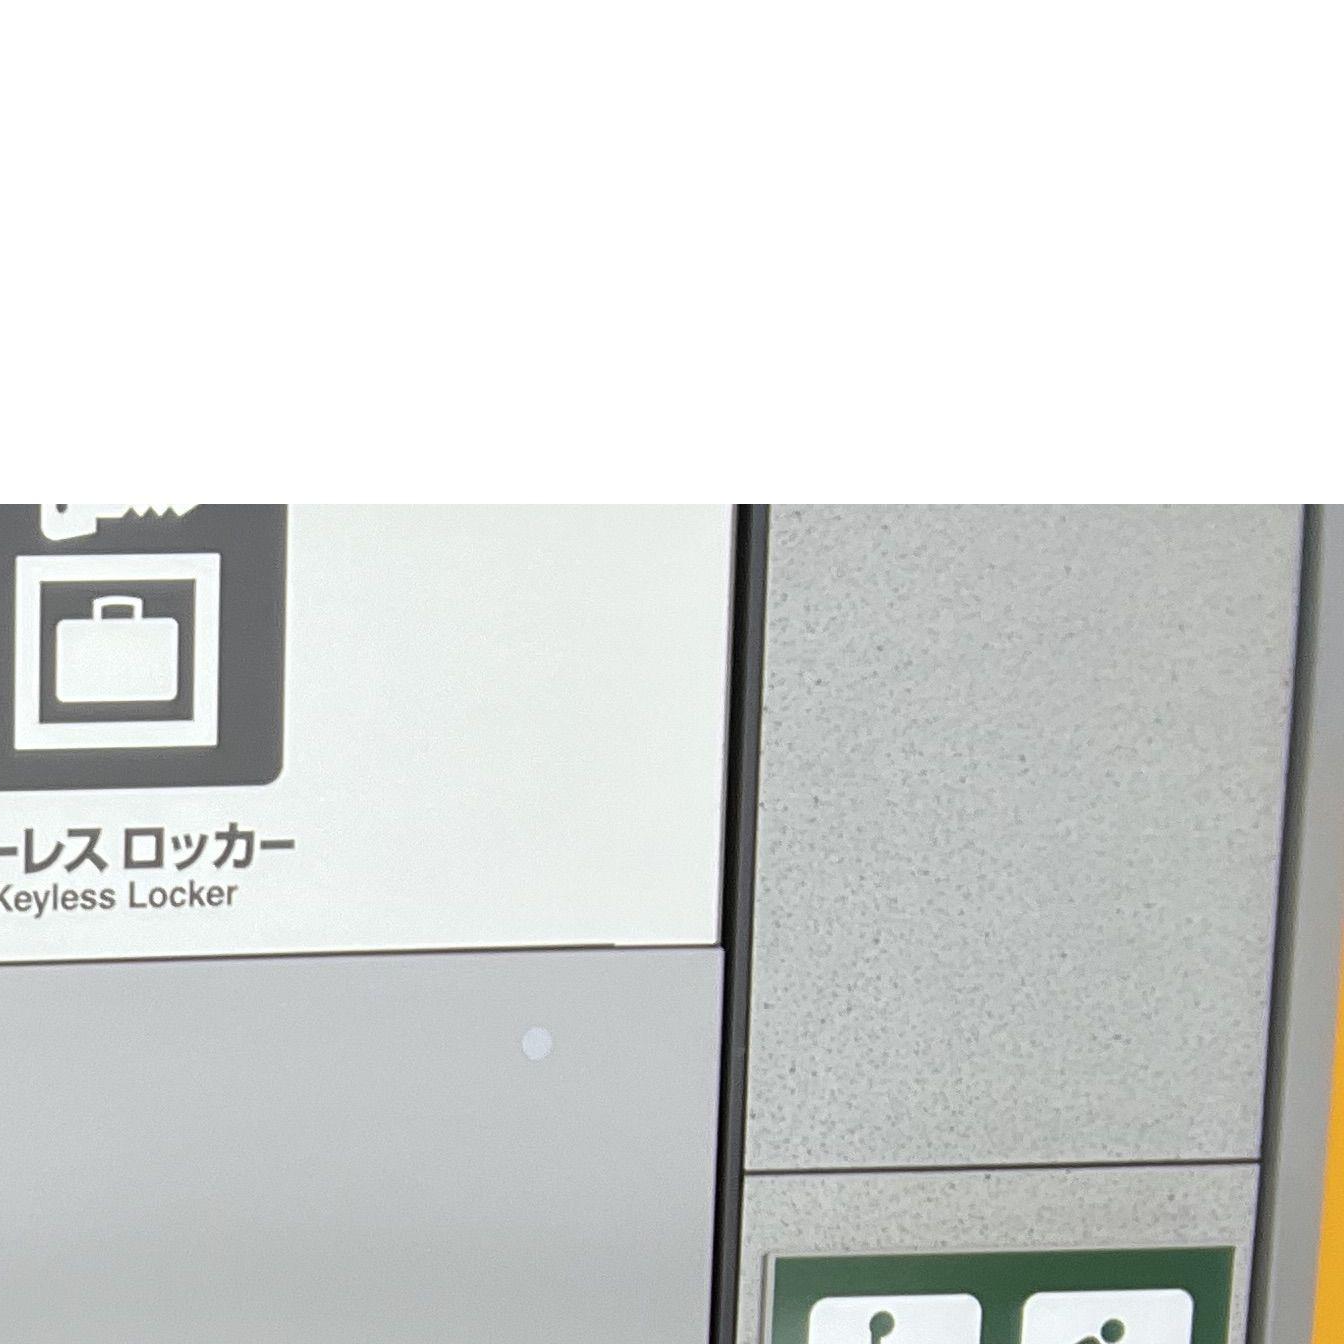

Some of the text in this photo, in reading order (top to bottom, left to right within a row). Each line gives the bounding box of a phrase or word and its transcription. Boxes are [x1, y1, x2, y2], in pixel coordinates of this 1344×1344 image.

[123, 821, 296, 871] ロッカー
[128, 880, 239, 909] Locker
